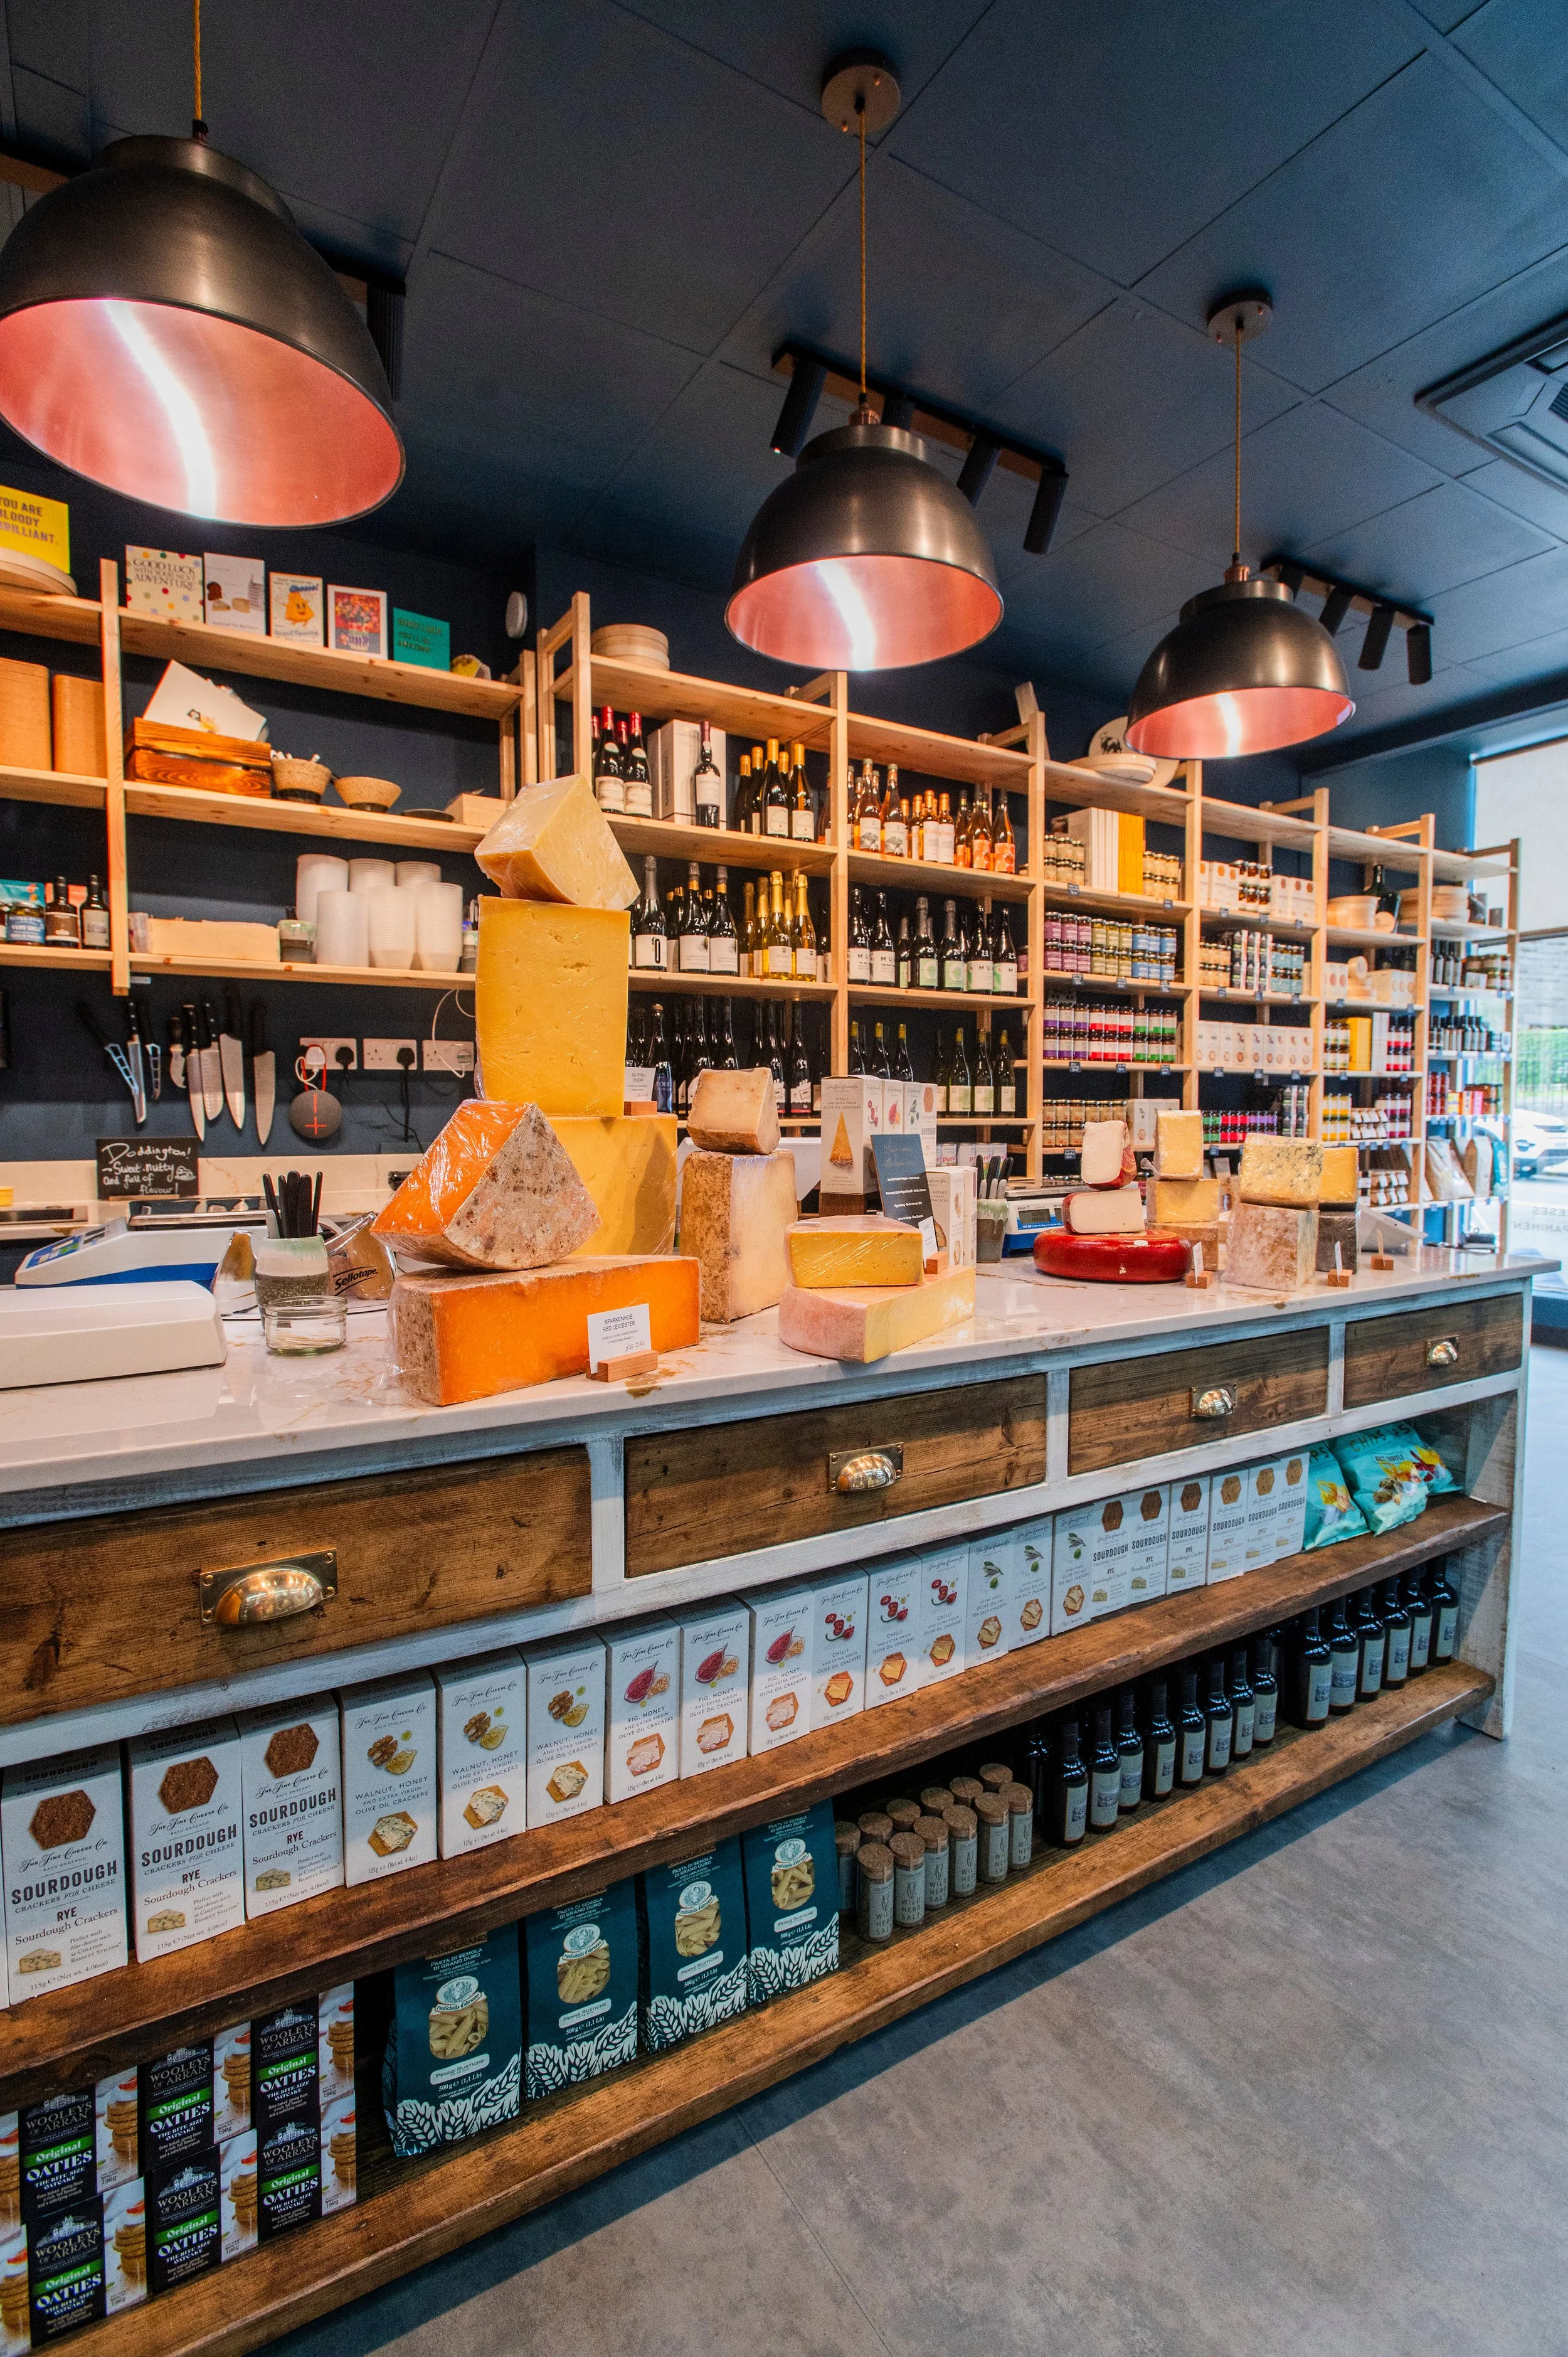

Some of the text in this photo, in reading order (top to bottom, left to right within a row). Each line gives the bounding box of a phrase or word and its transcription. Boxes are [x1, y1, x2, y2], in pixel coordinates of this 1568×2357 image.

[0, 497, 43, 517] OU ARE
[134, 558, 194, 574] GOOD LUCK
[135, 574, 193, 591] ADVENTURE
[636, 769, 645, 779] 39
[694, 917, 704, 926] 26
[101, 1143, 191, 1164] Doddington!
[124, 1174, 140, 1189] full
[142, 1173, 154, 1186] of
[335, 1269, 377, 1290] Sellotape
[605, 1314, 633, 1324] SPARKENHOE
[613, 1321, 635, 1330] LEICESTER
[1278, 1497, 1305, 1511] SOURDOUGH
[1248, 1507, 1277, 1522] SOURDOUGH
[1172, 1524, 1207, 1540] SOURDOUGH
[1213, 1516, 1245, 1531] SOURDOUGH
[1132, 1533, 1167, 1550] SOURDOUGH
[1093, 1543, 1128, 1562] SOURDOUGH
[832, 1648, 849, 1657] CHILLI
[817, 1666, 830, 1674] OLIVE
[840, 1655, 861, 1666] CRACKERS
[637, 1718, 652, 1727] EXTRA
[653, 1712, 669, 1720] VIRGIN
[643, 1706, 665, 1718] HONEY
[618, 1730, 635, 1739] OLIVE
[647, 1716, 674, 1730] CRACKERS
[399, 1775, 428, 1789] HONEY
[356, 1805, 376, 1815] OLIVE
[393, 1790, 428, 1806] CRACKERS
[379, 1792, 398, 1802] EXTRA
[401, 1786, 421, 1795] VIRGIN
[250, 1787, 336, 1828] SOURDOUGH
[253, 1805, 336, 1836] CRACKERS FOR CHEESE
[141, 1824, 237, 1867] SOURDOUGH
[287, 1831, 304, 1844] RYE
[252, 1831, 337, 1865] Sourdough Crackers
[60, 1857, 87, 1868] ENGLAND
[11, 1860, 117, 1905] SOURDOUGH
[182, 1869, 201, 1883] RYE
[15, 1878, 116, 1913] CRACKERS FOR CHEESE
[57, 1907, 77, 1922] RYE
[15, 1908, 118, 1945] Sourdough Crackers
[70, 1935, 89, 1944] Perfect
[82, 1937, 98, 1947] cheeses
[99, 1933, 112, 1941] such
[431, 1959, 450, 1967] PASTA
[458, 1948, 483, 1958] SEMOLA
[441, 1959, 463, 1969] GRANO
[464, 1953, 480, 1962] DURO
[58, 1973, 72, 1982] (Net
[85, 1961, 109, 1972] 4.06oz)
[260, 2021, 316, 2045] WOOLEYS
[275, 2030, 312, 2048] ARRAN
[268, 2056, 307, 2075] Original
[436, 2058, 485, 2078] PENNE RUSTICHE
[260, 2065, 316, 2093] OATIES
[472, 2072, 482, 2080] Lb)
[267, 2091, 280, 2099] THE
[281, 2086, 295, 2095] BITE
[275, 2088, 302, 2100] OATCAKE
[263, 2134, 319, 2159] WOOLEYS
[263, 2176, 319, 2206] OATIES
[35, 2227, 100, 2258] WOOLEYS
[35, 2274, 102, 2310] OATIES
